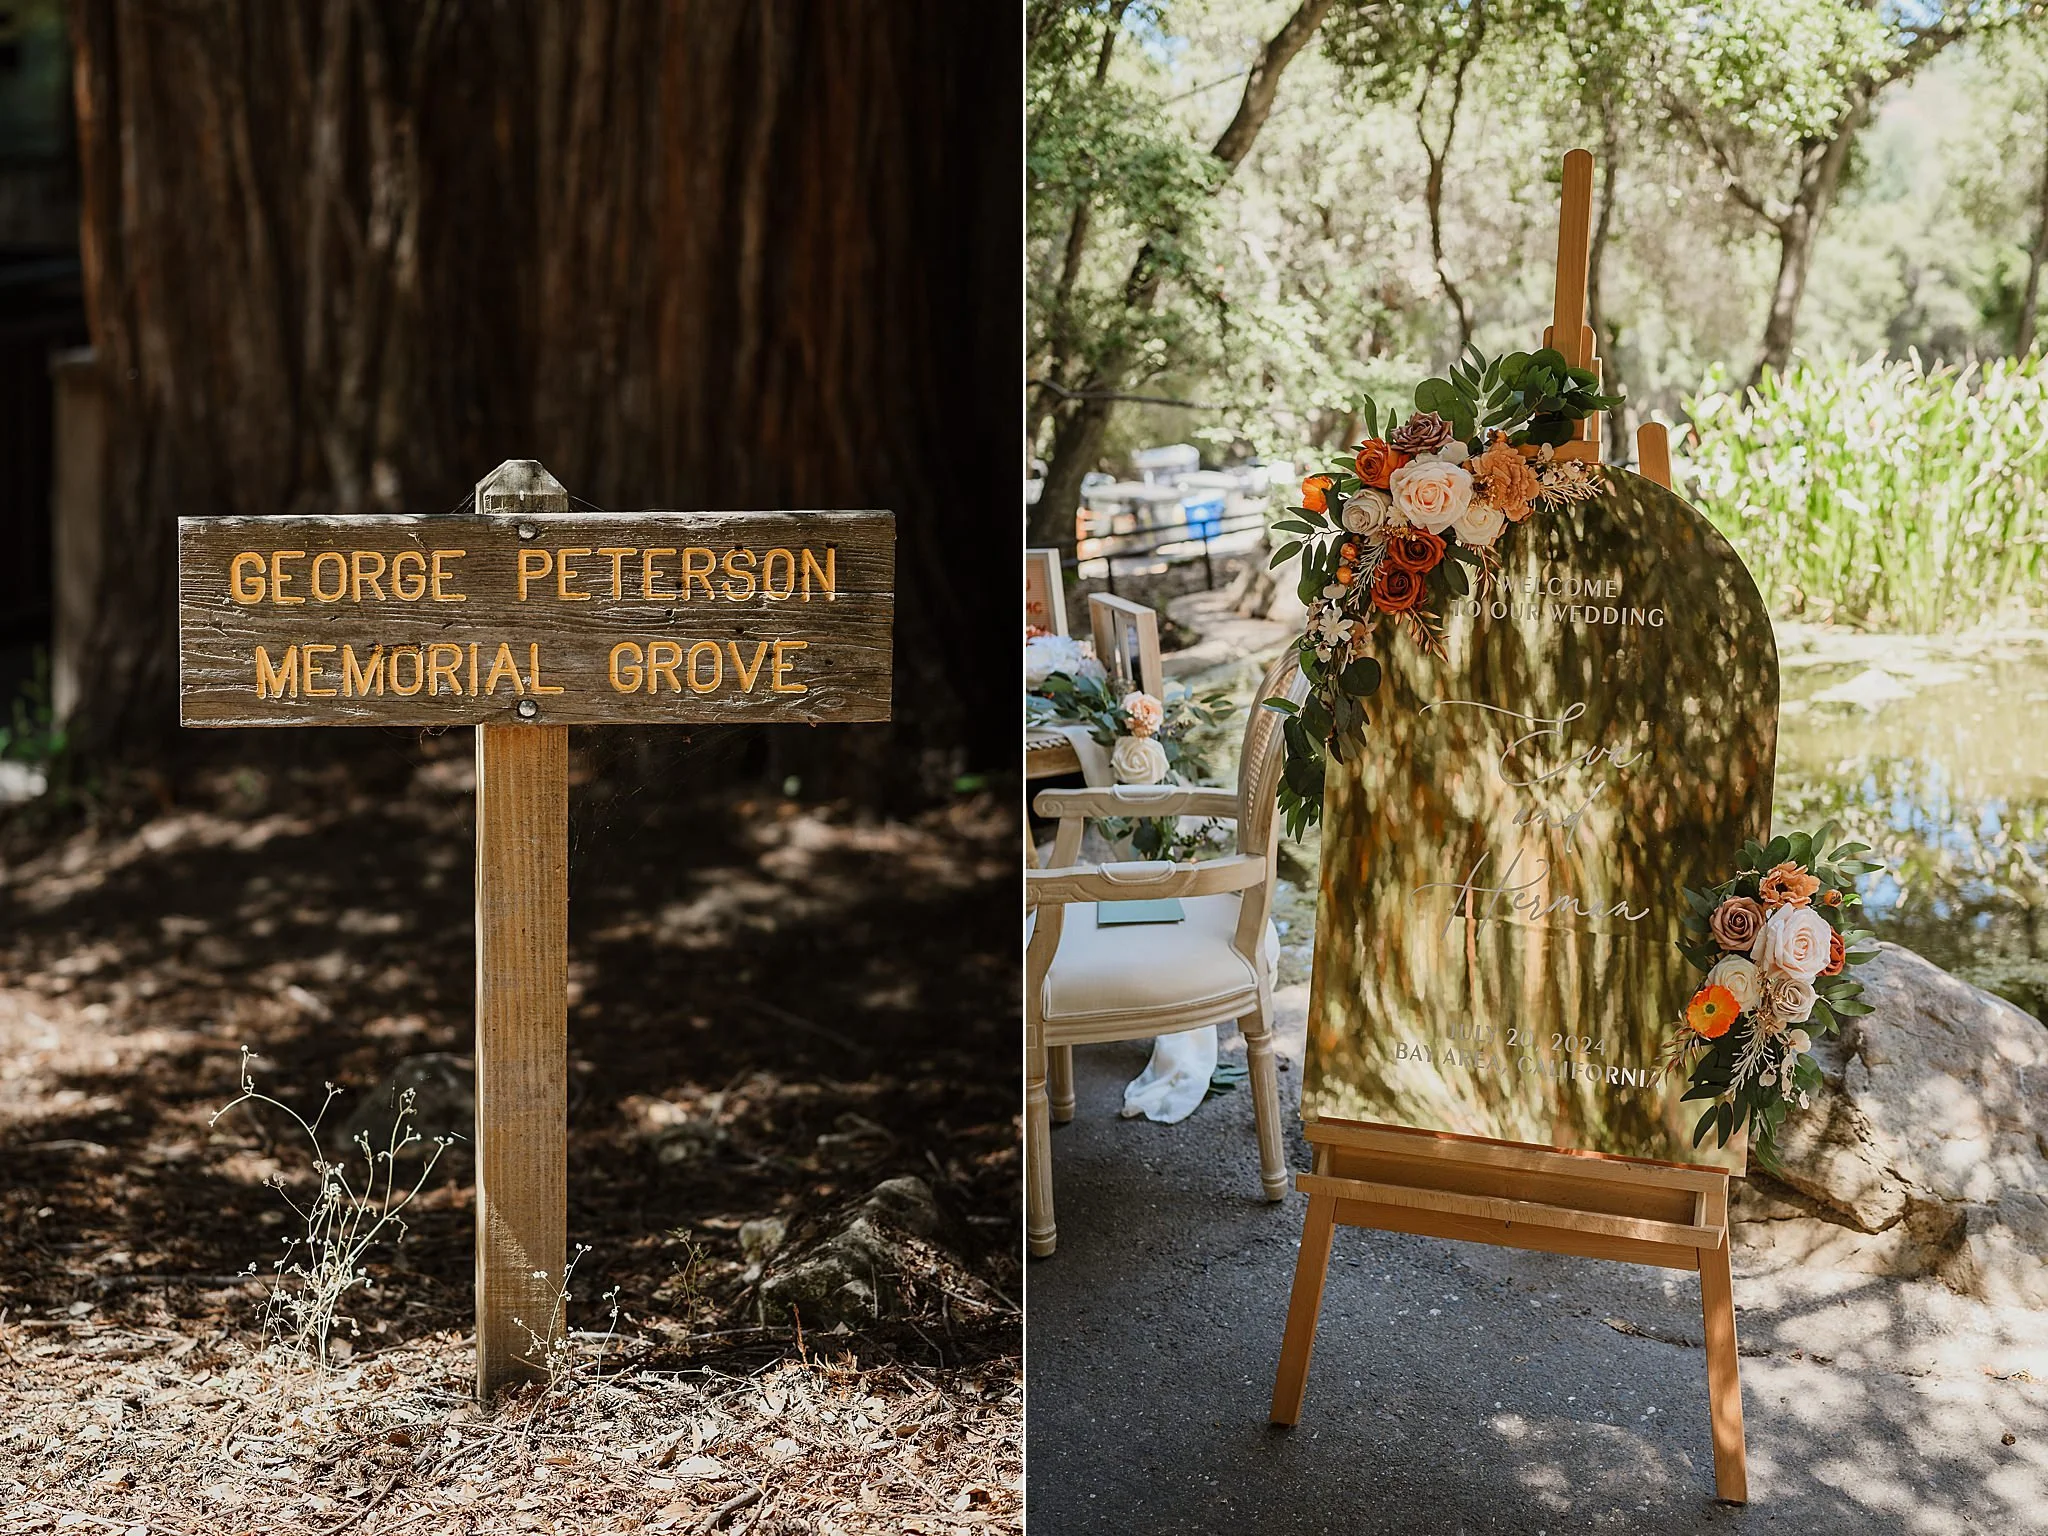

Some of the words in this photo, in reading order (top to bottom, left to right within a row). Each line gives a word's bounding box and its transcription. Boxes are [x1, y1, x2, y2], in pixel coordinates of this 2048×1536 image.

[230, 549, 467, 604] GEORGE
[517, 547, 837, 602] PETERSON
[1500, 575, 1617, 598] WELCOME
[1451, 599, 1482, 618] TO
[1490, 601, 1539, 621] OUR
[1550, 604, 1664, 627] WEDDING
[255, 641, 565, 699] MEMORIAL
[608, 639, 808, 694] GROVE
[1418, 700, 1642, 786] Eva
[1512, 780, 1606, 853] and
[1409, 848, 1650, 941] Herman
[1395, 1042, 1433, 1063] BAY
[1442, 1047, 1507, 1075] AREA,
[1446, 1023, 1498, 1046] JULY
[1551, 1033, 1606, 1056] 2024
